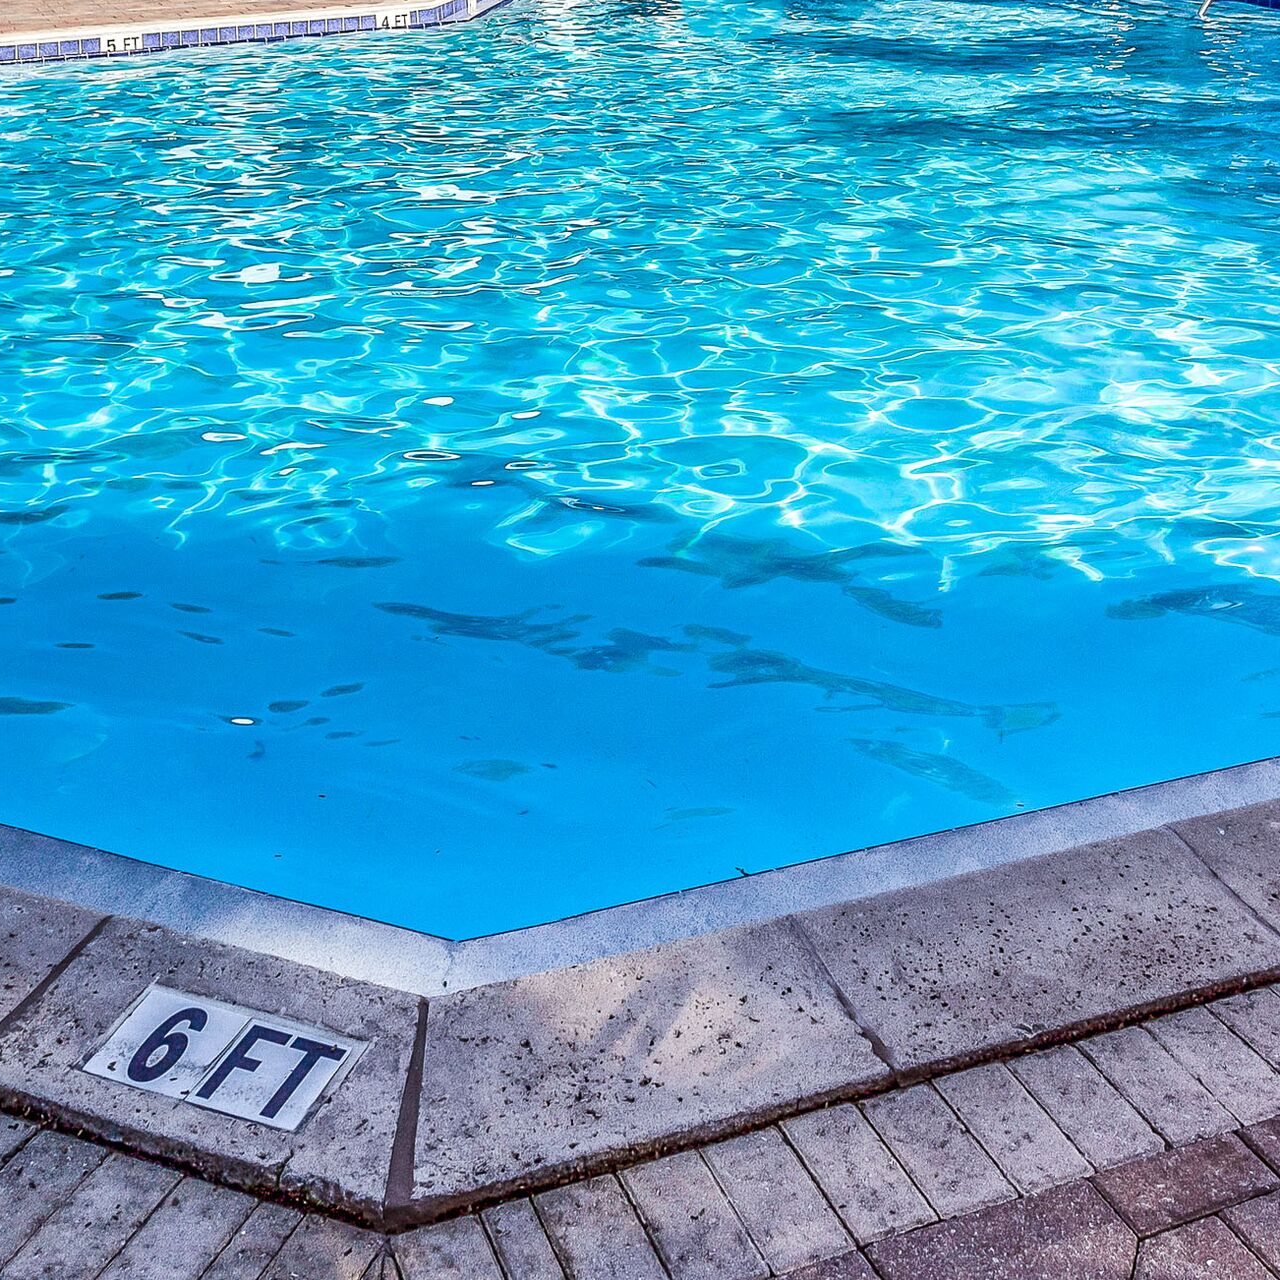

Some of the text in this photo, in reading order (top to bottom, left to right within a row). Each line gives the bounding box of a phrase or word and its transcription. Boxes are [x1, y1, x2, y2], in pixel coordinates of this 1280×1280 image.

[381, 14, 408, 29] 4 FT
[107, 36, 140, 52] 5 FT
[126, 1007, 348, 1119] 6 FT
